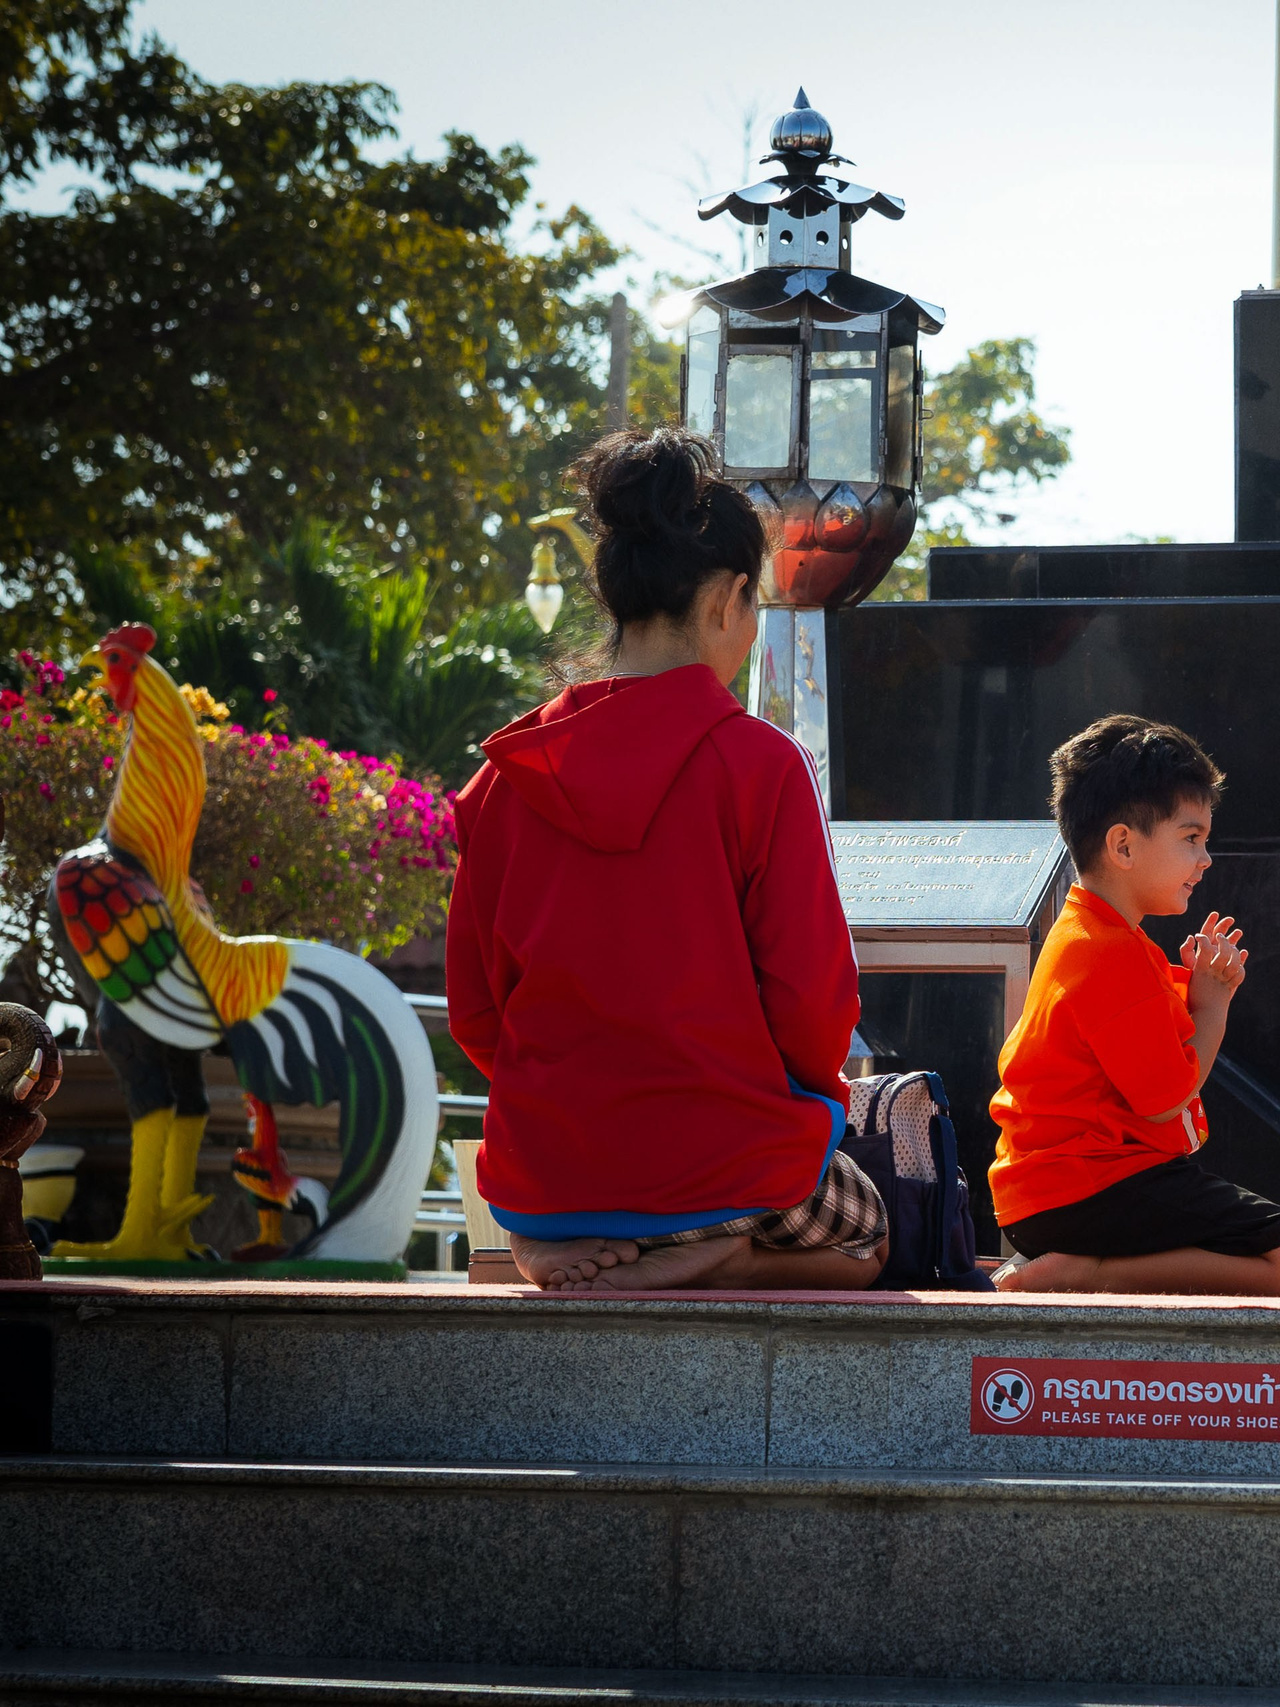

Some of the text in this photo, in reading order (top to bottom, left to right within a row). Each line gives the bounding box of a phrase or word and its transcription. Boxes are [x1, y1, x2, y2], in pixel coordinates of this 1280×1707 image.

[831, 830, 968, 848] าประจำพระองค์
[1041, 1411, 1101, 1425] PLEASE
[1106, 1412, 1147, 1426] TAKE
[1152, 1413, 1182, 1427] OFF
[1188, 1415, 1231, 1428] YOUR
